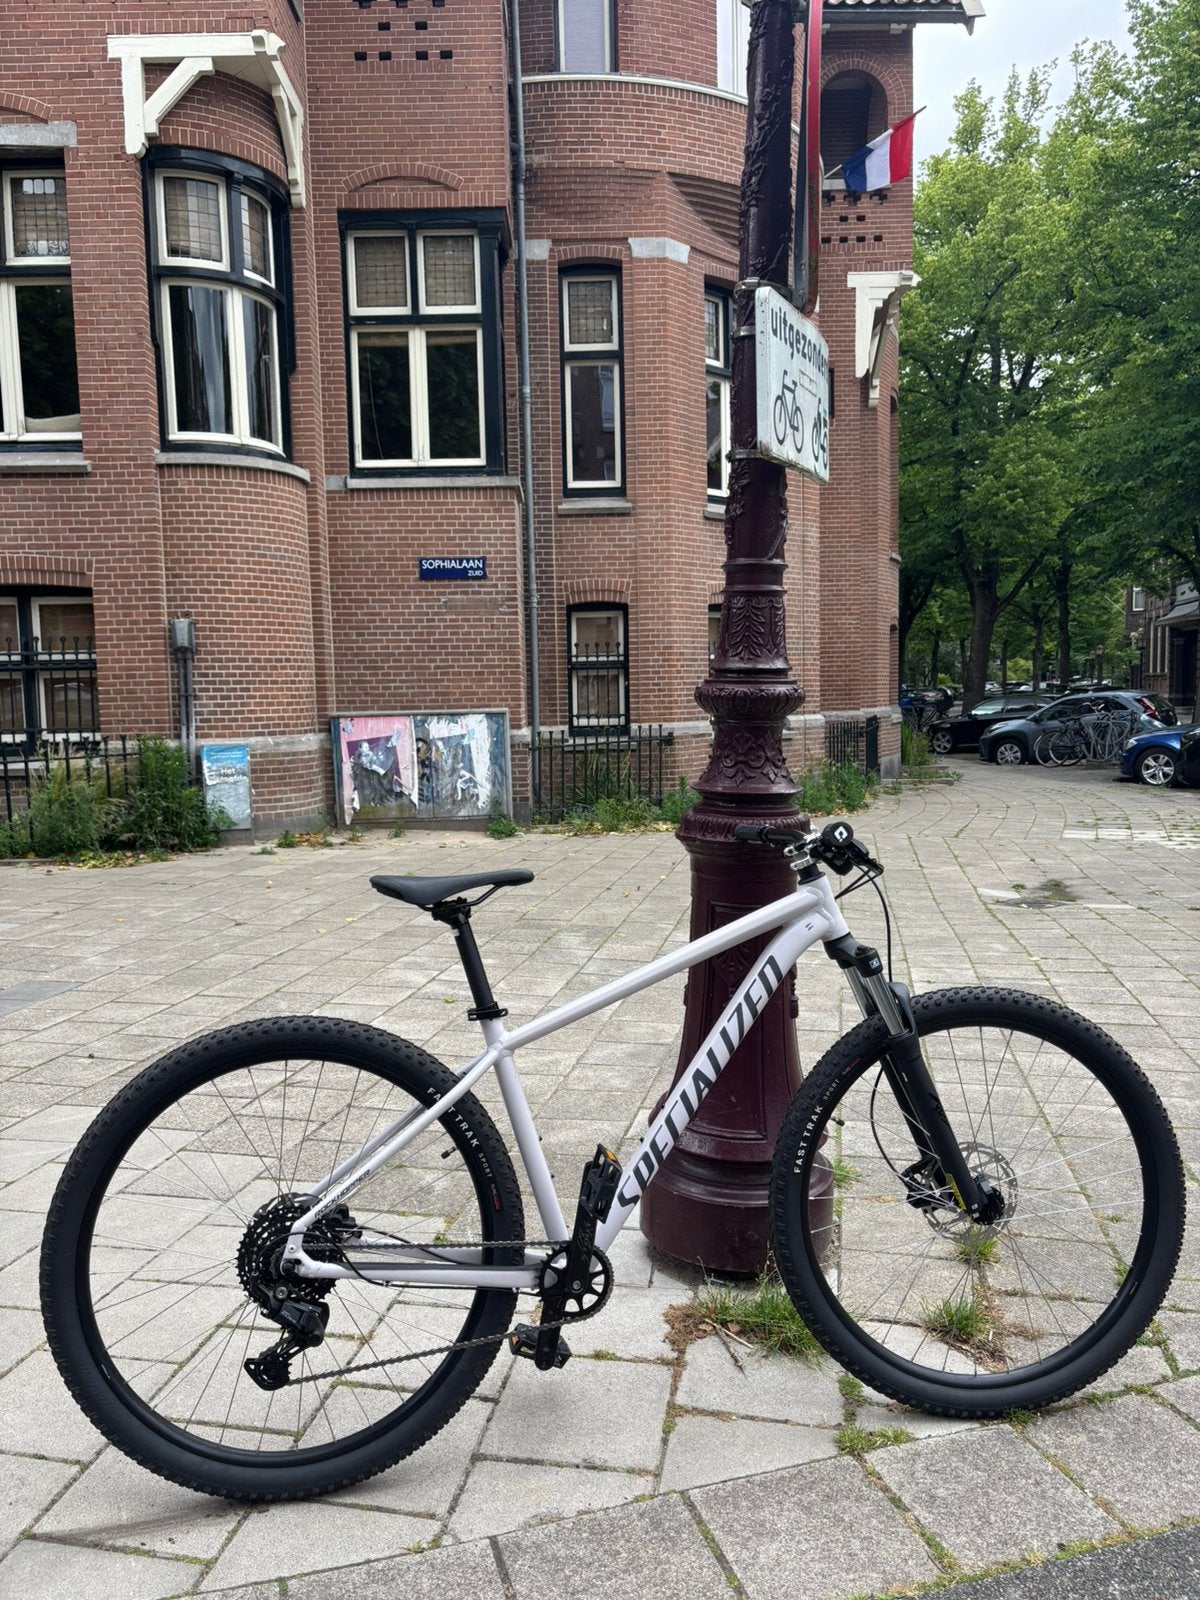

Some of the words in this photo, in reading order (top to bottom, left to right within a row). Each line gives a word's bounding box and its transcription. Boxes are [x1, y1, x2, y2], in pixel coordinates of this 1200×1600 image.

[771, 306, 829, 382] uitgezonder
[421, 559, 483, 569] SOPHIALAAN
[617, 954, 783, 1208] SPECIALIZED
[427, 1087, 456, 1113] FAT
[455, 1114, 480, 1148] TRAK
[478, 1152, 493, 1178] SPORT
[793, 1141, 808, 1173] FAST
[803, 1105, 824, 1137] TRAK
[823, 1079, 840, 1100] SPORT
[314, 1168, 371, 1219] ROCKHOPPER
